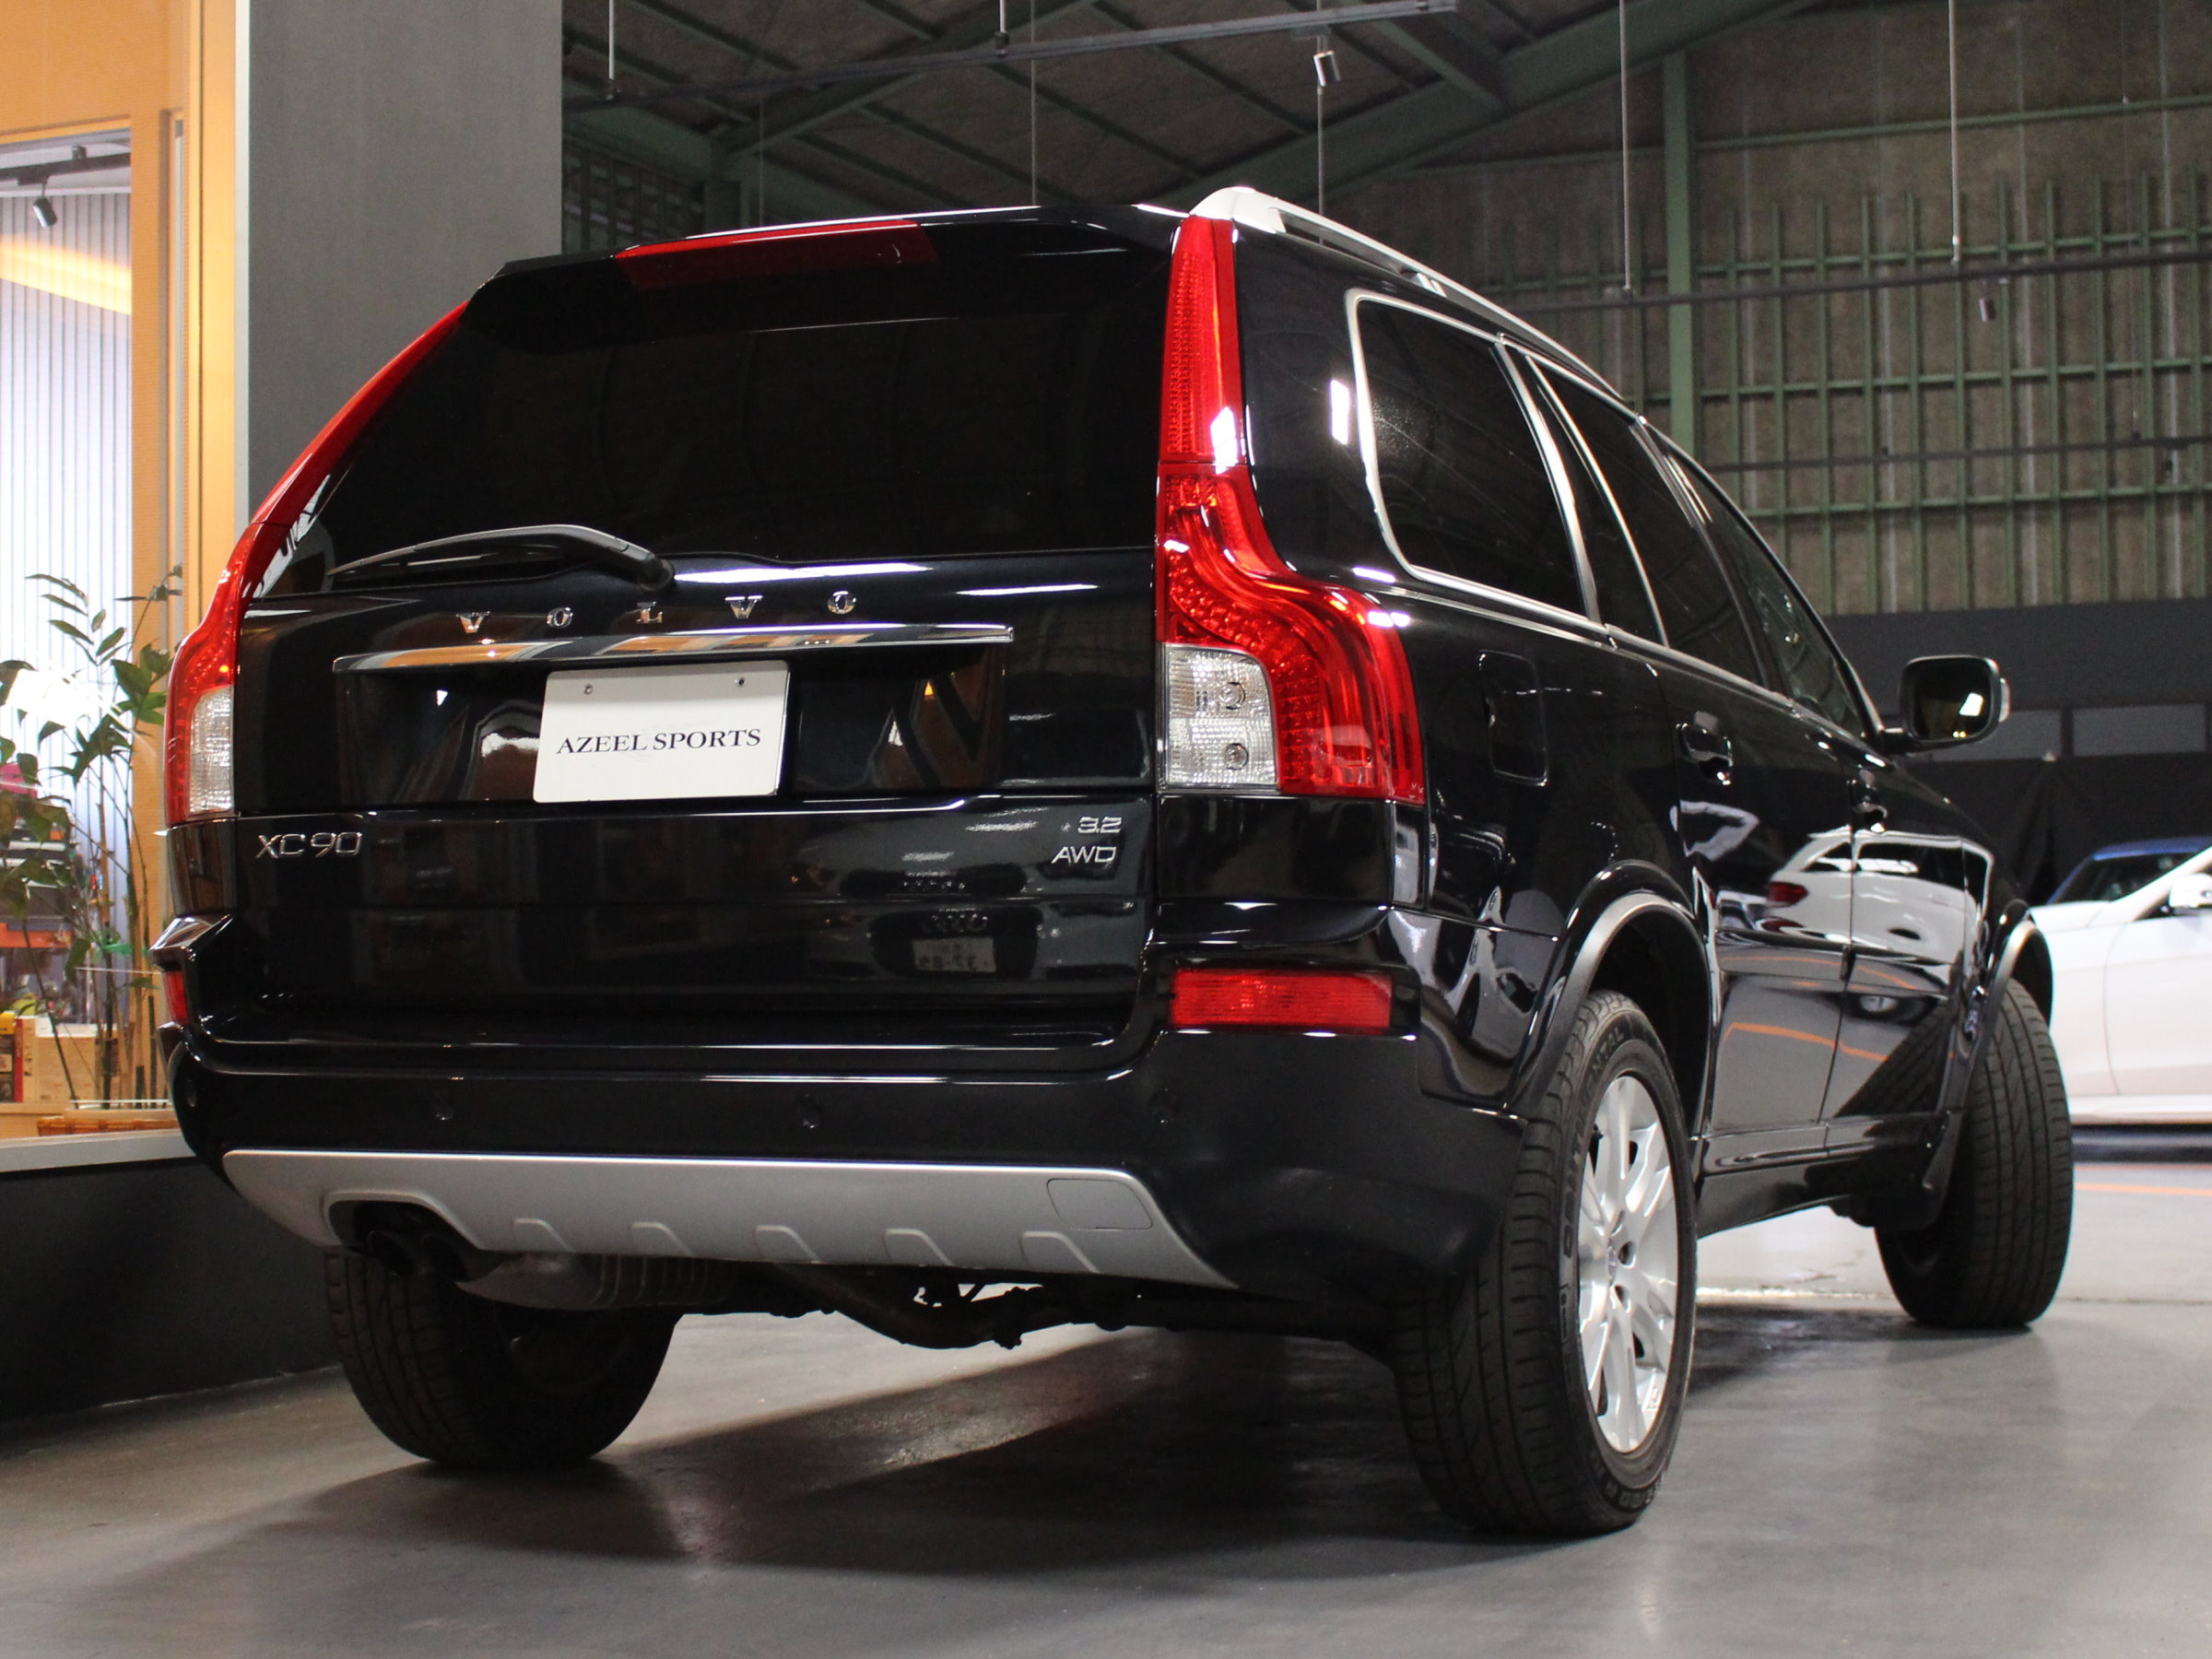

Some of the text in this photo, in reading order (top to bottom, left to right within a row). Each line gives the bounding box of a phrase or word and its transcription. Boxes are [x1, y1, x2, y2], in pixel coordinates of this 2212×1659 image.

[455, 590, 857, 633] VOLVO
[556, 727, 762, 755] AZEEL SPORTS
[255, 831, 363, 859] XC90
[1051, 845, 1117, 865] AWD
